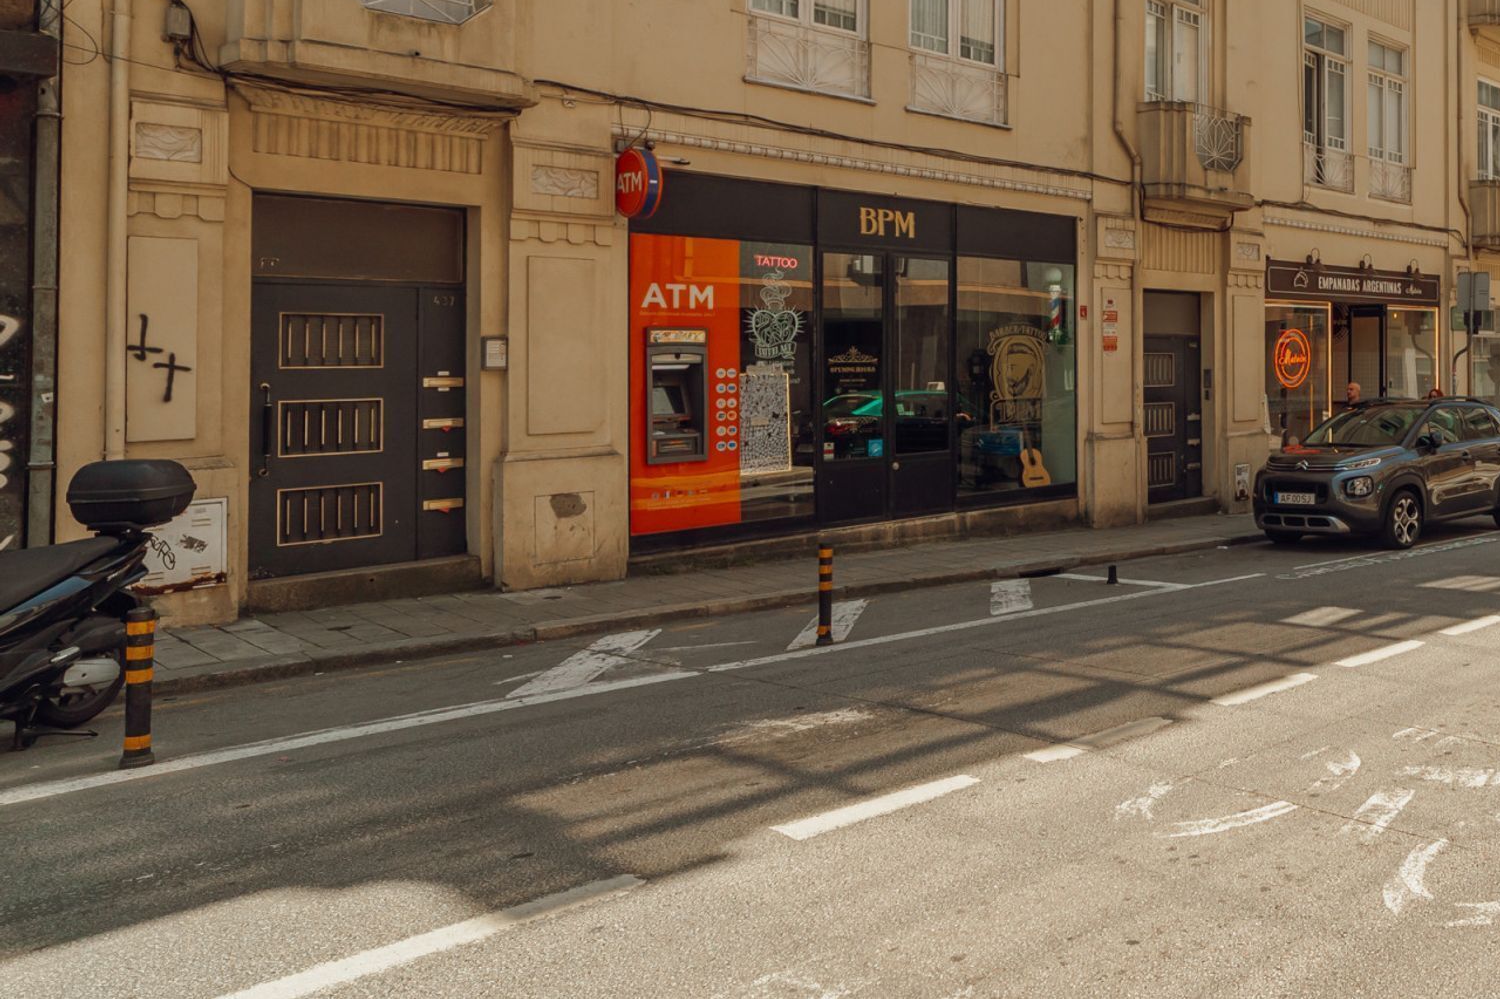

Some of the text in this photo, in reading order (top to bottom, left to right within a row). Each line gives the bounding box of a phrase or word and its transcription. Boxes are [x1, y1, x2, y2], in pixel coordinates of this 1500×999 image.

[617, 171, 642, 193] ATM
[860, 206, 915, 238] BPM
[755, 255, 798, 269] TATTOO
[641, 283, 714, 309] ATM
[1318, 276, 1360, 292] EMPANADAS
[1362, 281, 1402, 295] ARGENTINAS
